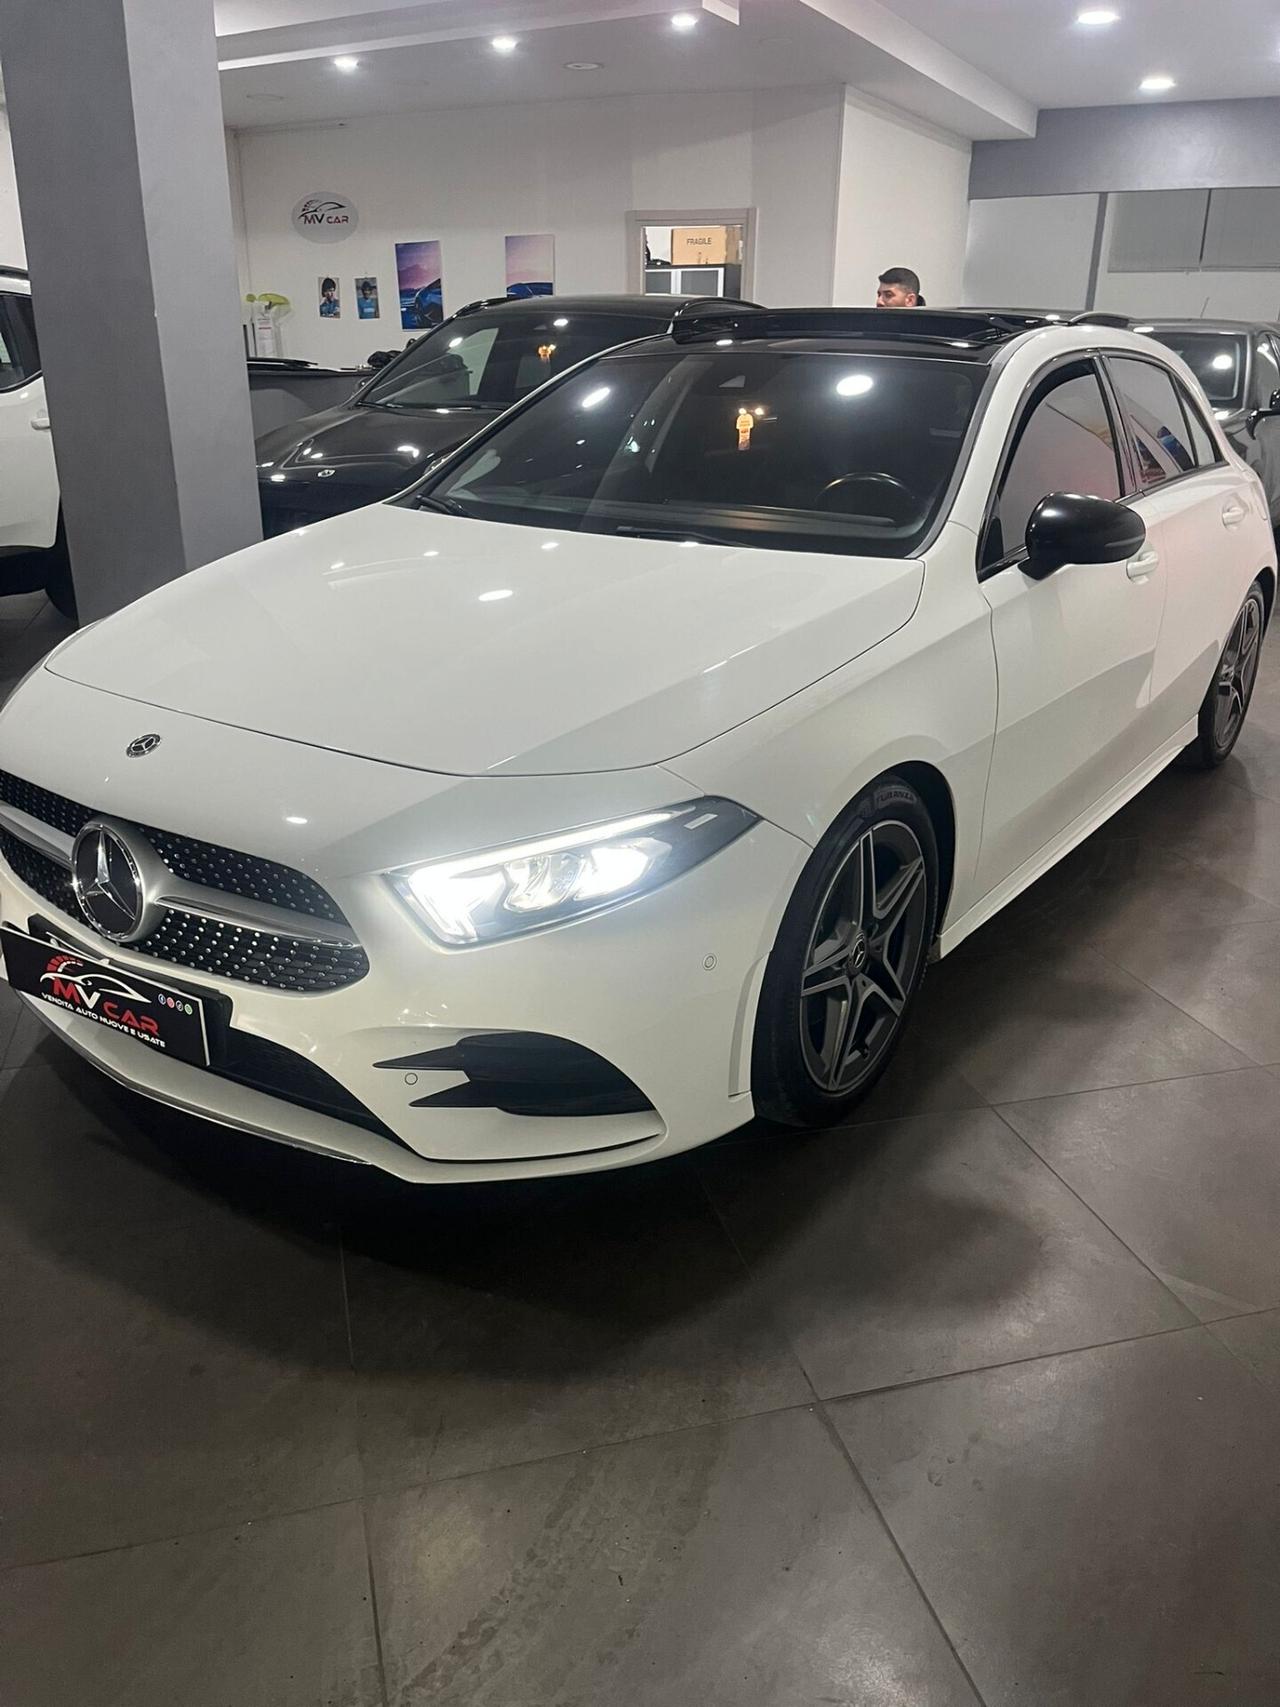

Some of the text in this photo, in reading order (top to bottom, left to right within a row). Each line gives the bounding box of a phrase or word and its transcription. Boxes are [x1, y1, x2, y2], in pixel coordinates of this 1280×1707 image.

[304, 213, 349, 224] MV CAR
[41, 992, 166, 1048] VENDITA AUTO NUOVE E USATE
[52, 977, 160, 1036] MV CAR
